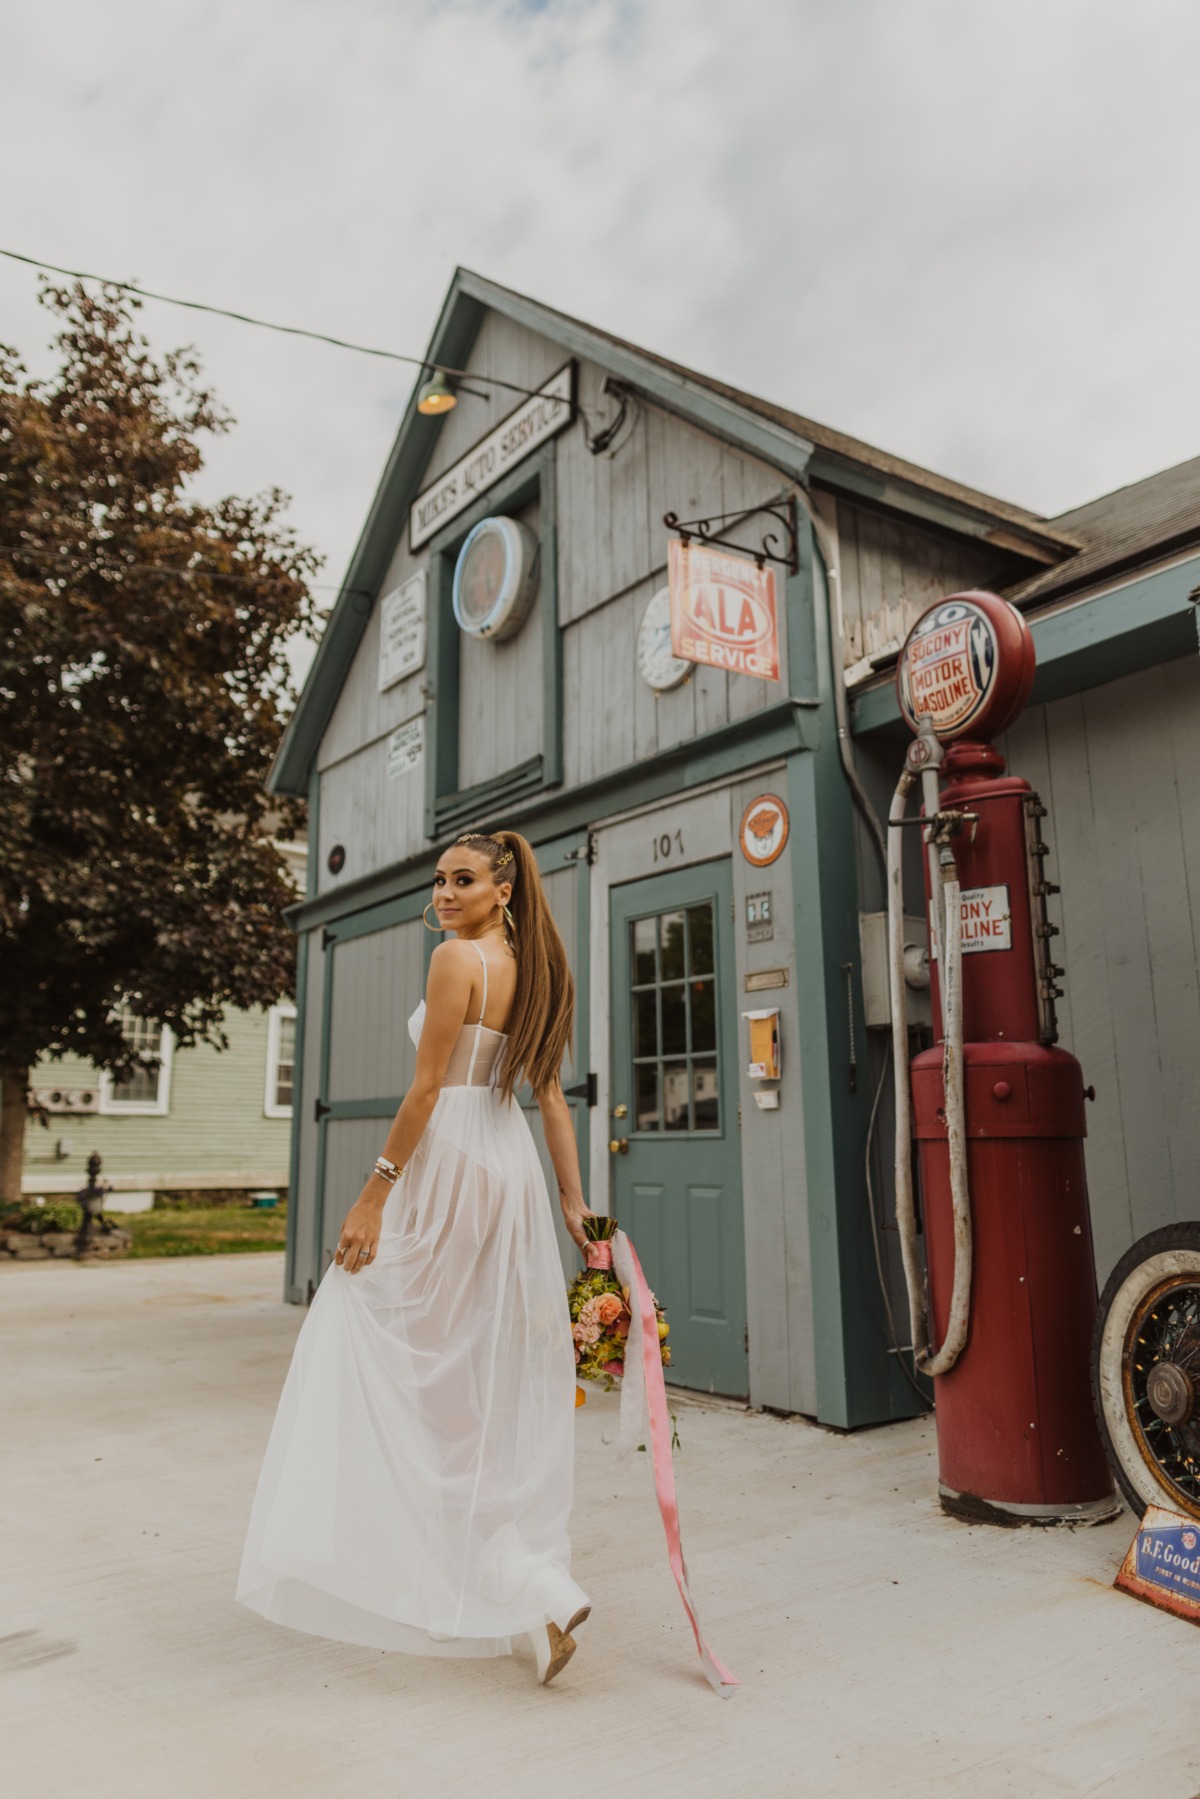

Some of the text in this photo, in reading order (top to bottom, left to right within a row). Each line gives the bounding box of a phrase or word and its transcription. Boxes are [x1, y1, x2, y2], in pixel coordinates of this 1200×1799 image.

[462, 445, 496, 495] AUTO
[500, 387, 565, 461] SERVICE
[682, 548, 769, 588] ERGENCY
[693, 587, 757, 637] ALA
[680, 637, 773, 676] SERVICE
[912, 628, 963, 664] SOCONY
[914, 657, 963, 694] MOTOR
[916, 676, 970, 713] GASOLINE
[960, 899, 993, 920] ONY
[961, 893, 984, 901] Quality
[960, 918, 1004, 940] LINE
[1141, 1535, 1200, 1574] B.F.Good
[1155, 1565, 1173, 1579] FIRST
[1173, 1574, 1182, 1582] IN
